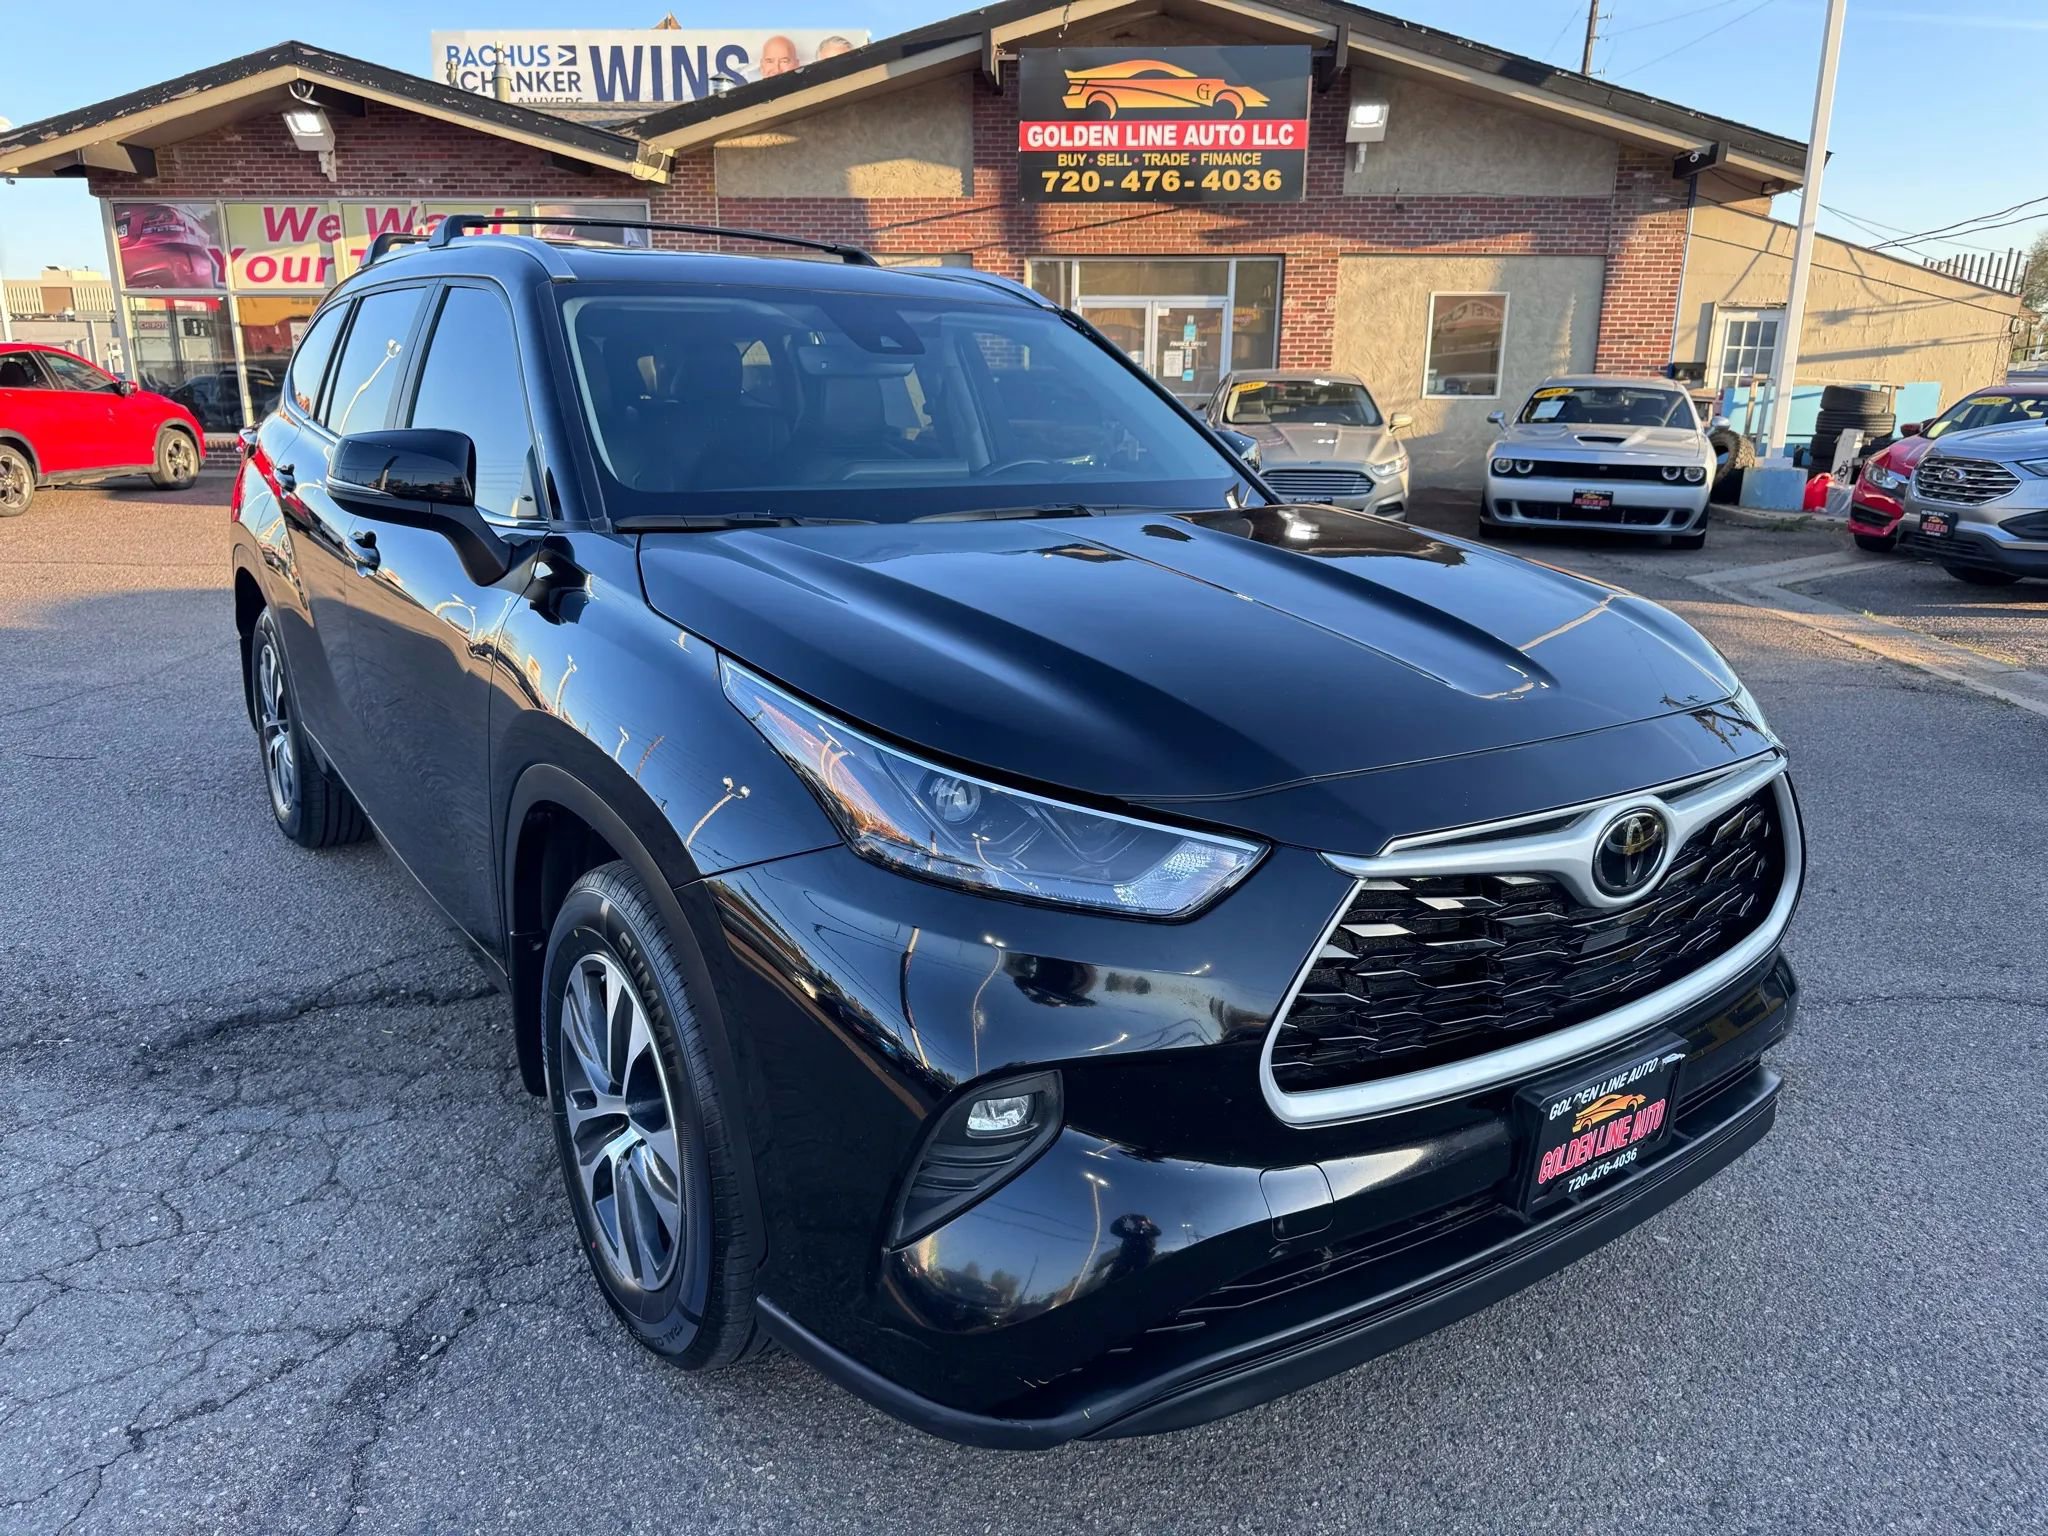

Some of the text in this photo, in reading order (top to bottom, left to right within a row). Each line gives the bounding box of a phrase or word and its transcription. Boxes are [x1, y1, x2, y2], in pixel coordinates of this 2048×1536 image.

[446, 44, 551, 67] BACHUS
[588, 44, 750, 102] WINS
[449, 70, 582, 93] CHNKER
[1027, 124, 1295, 147] GOLDEN LINE AUTO LLC
[1057, 153, 1262, 167] BUY SELL TRADE FINANCE
[263, 206, 505, 243] We Wat
[208, 248, 335, 283] Your
[1549, 1057, 1659, 1121] GOLDEN LINE AUTO
[1538, 1098, 1666, 1185] GOLDEN LINE AUTO
[1568, 1147, 1638, 1193] 720-476-4036
